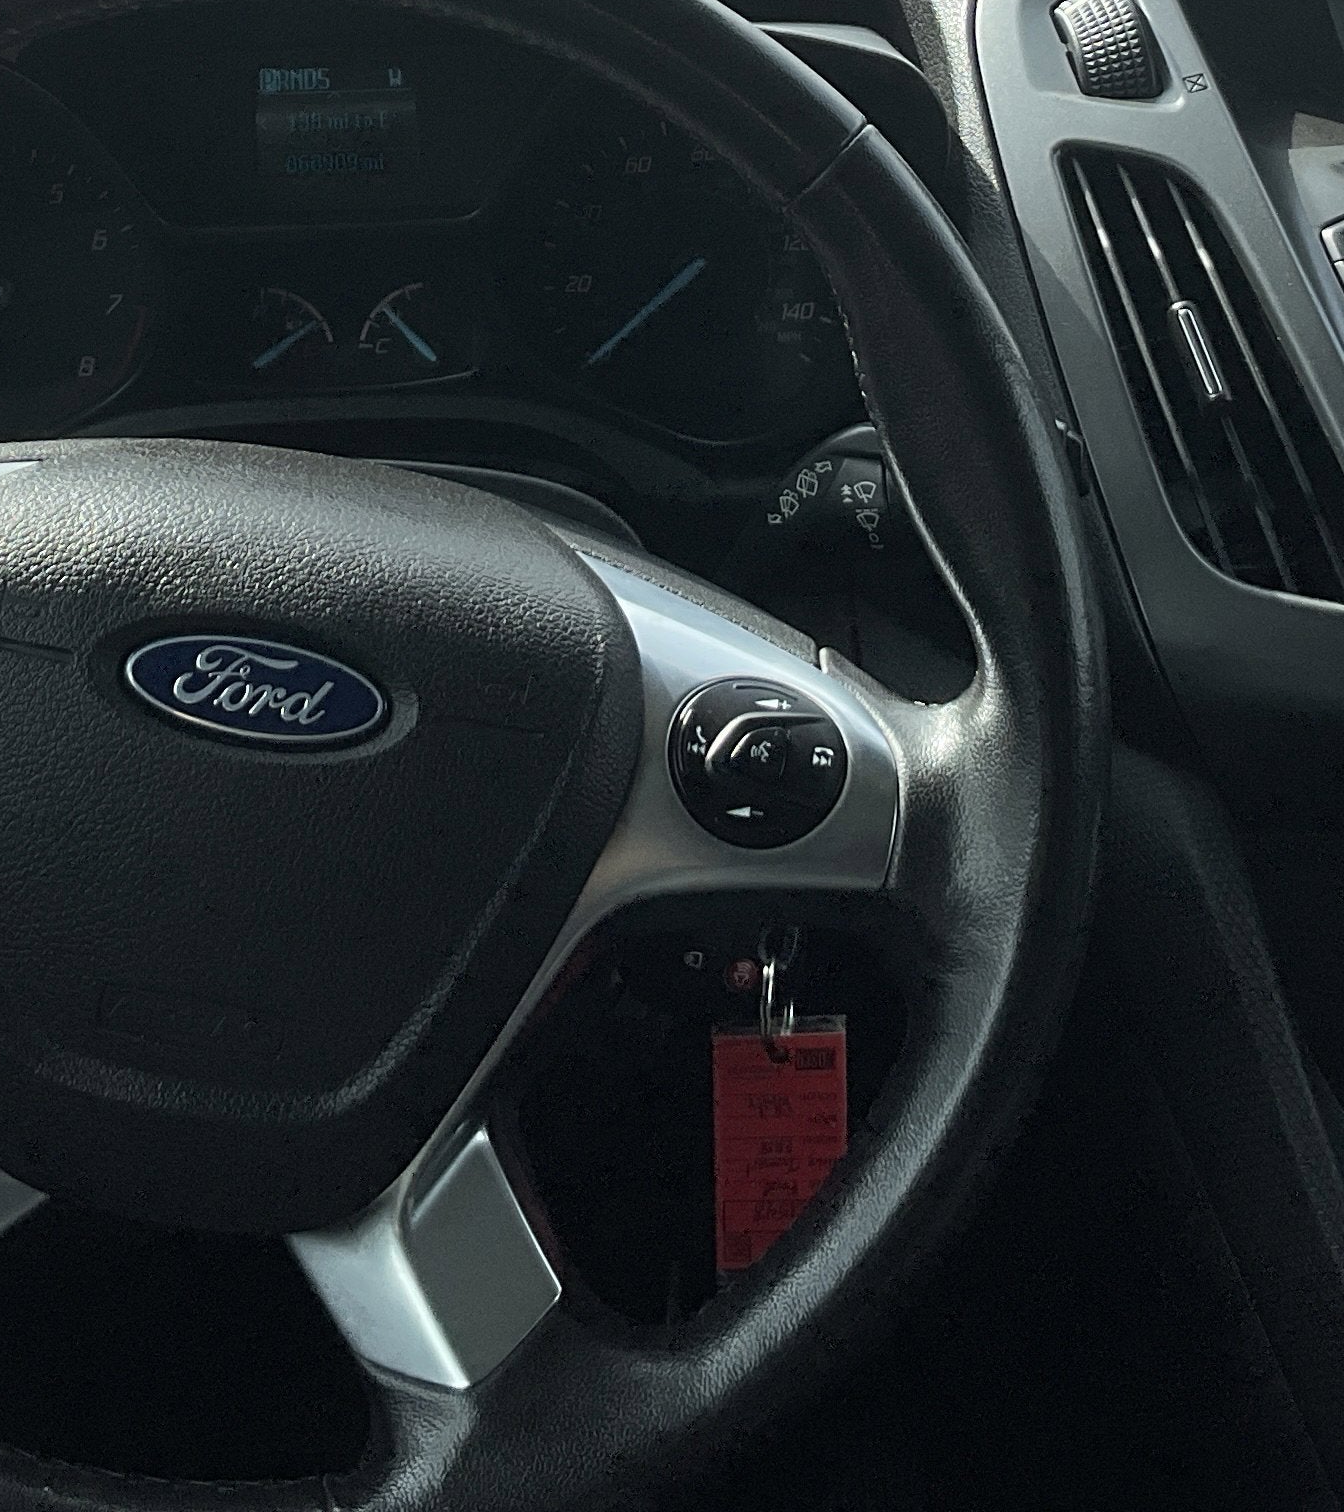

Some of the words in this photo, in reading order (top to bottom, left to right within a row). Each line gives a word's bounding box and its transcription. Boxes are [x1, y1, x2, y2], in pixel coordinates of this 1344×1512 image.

[624, 157, 652, 174] 60
[91, 229, 108, 251] 6
[564, 273, 593, 294] 20
[104, 293, 124, 316] 7
[781, 301, 815, 321] 140
[374, 337, 392, 355] C
[77, 355, 96, 378] 8
[172, 644, 335, 725] Ford
